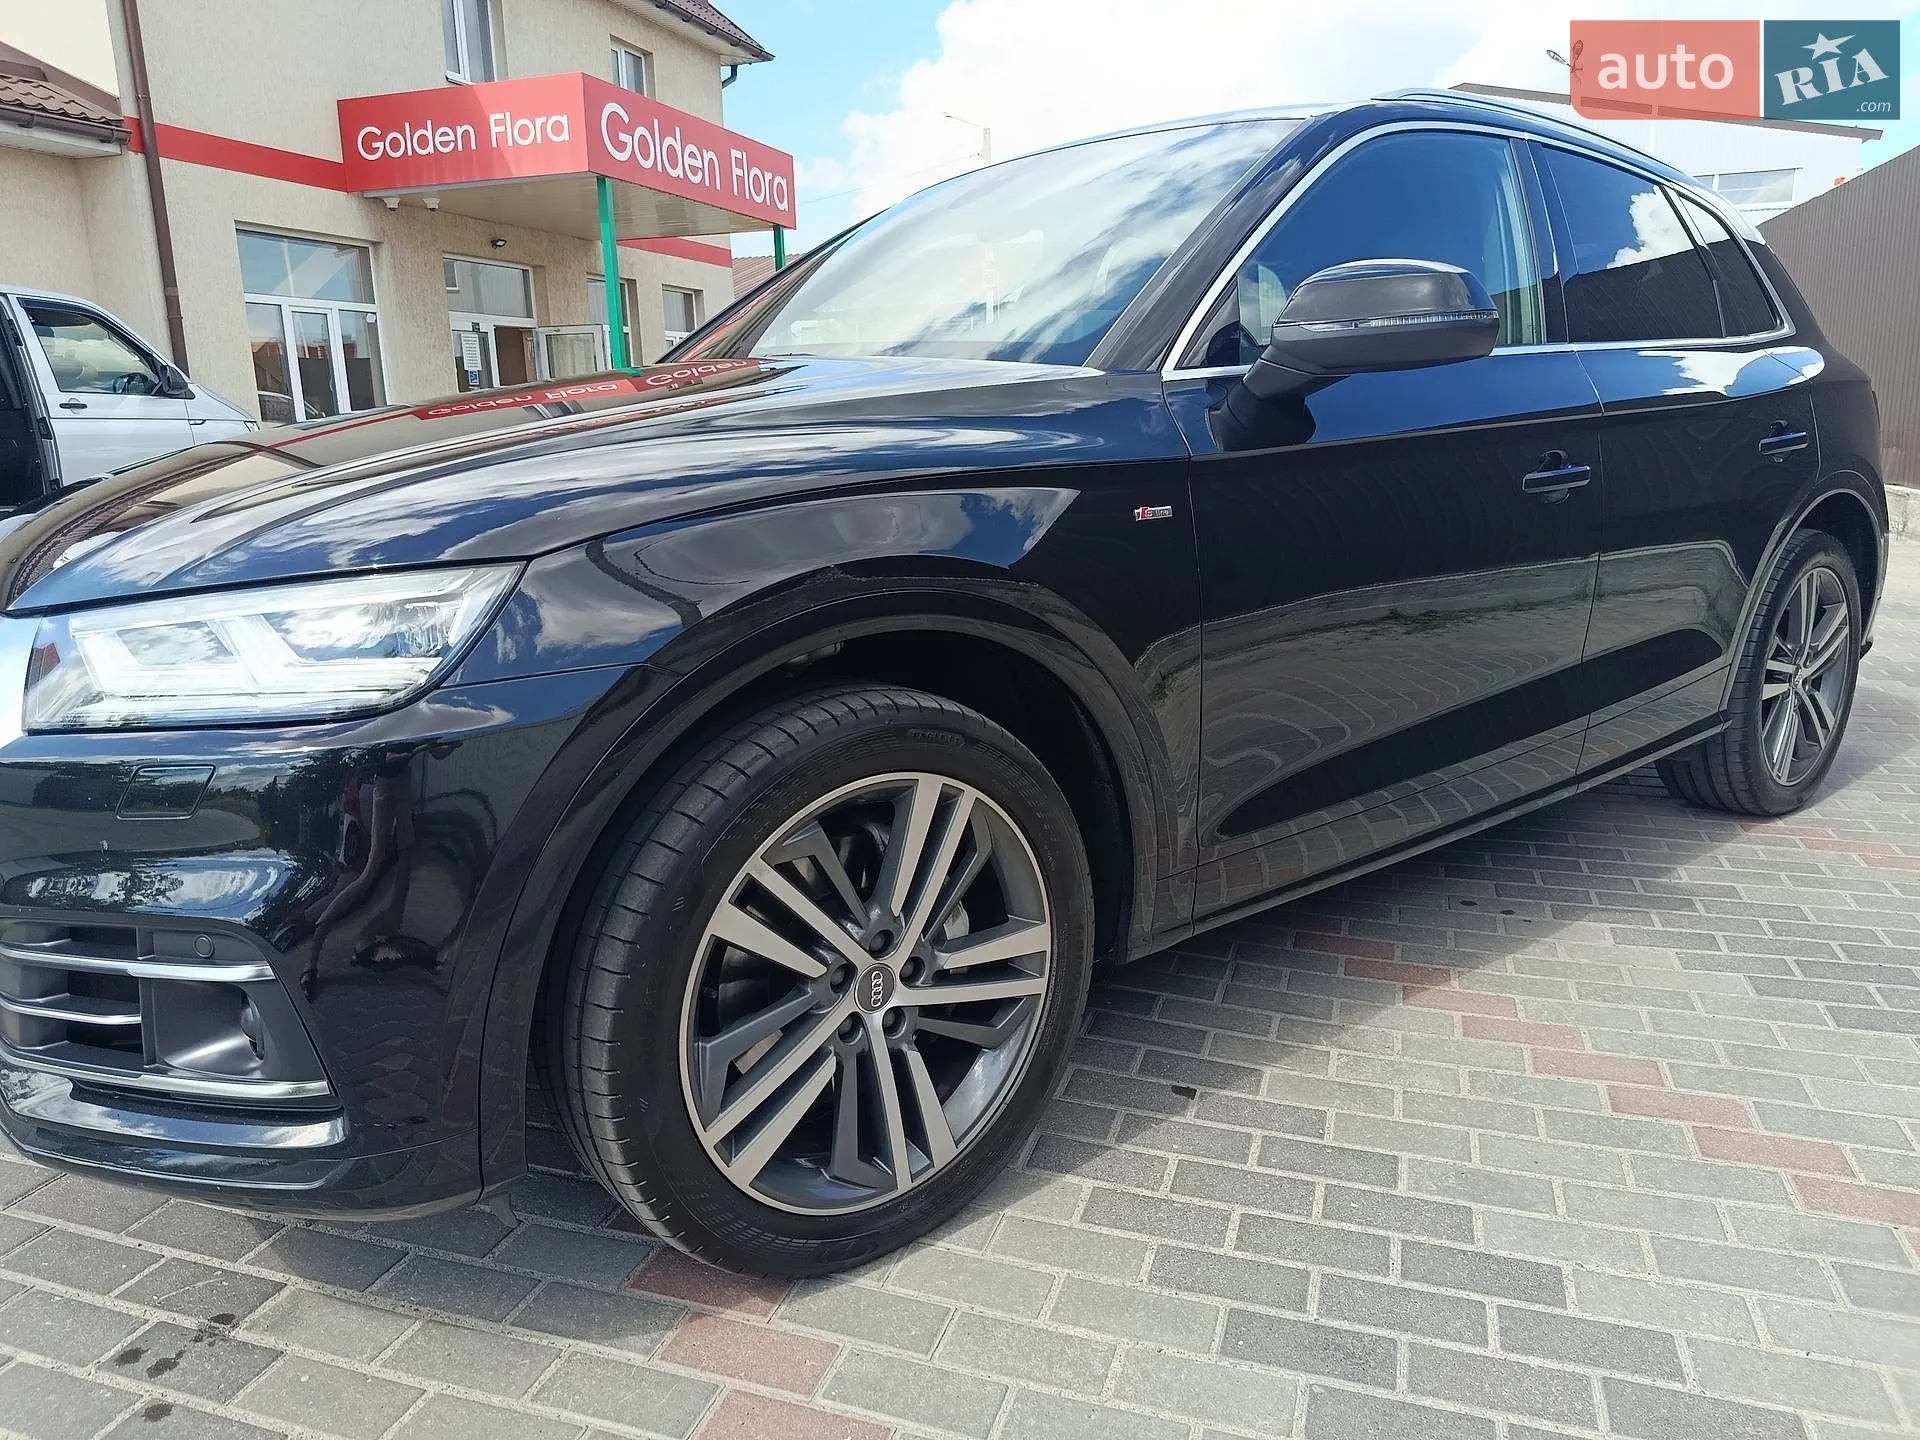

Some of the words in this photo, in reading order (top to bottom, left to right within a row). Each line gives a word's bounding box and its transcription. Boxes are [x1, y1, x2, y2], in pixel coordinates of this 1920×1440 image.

[357, 120, 476, 161] Golden
[490, 112, 570, 148] Flora
[601, 102, 721, 190] Golden
[731, 148, 789, 212] Flora
